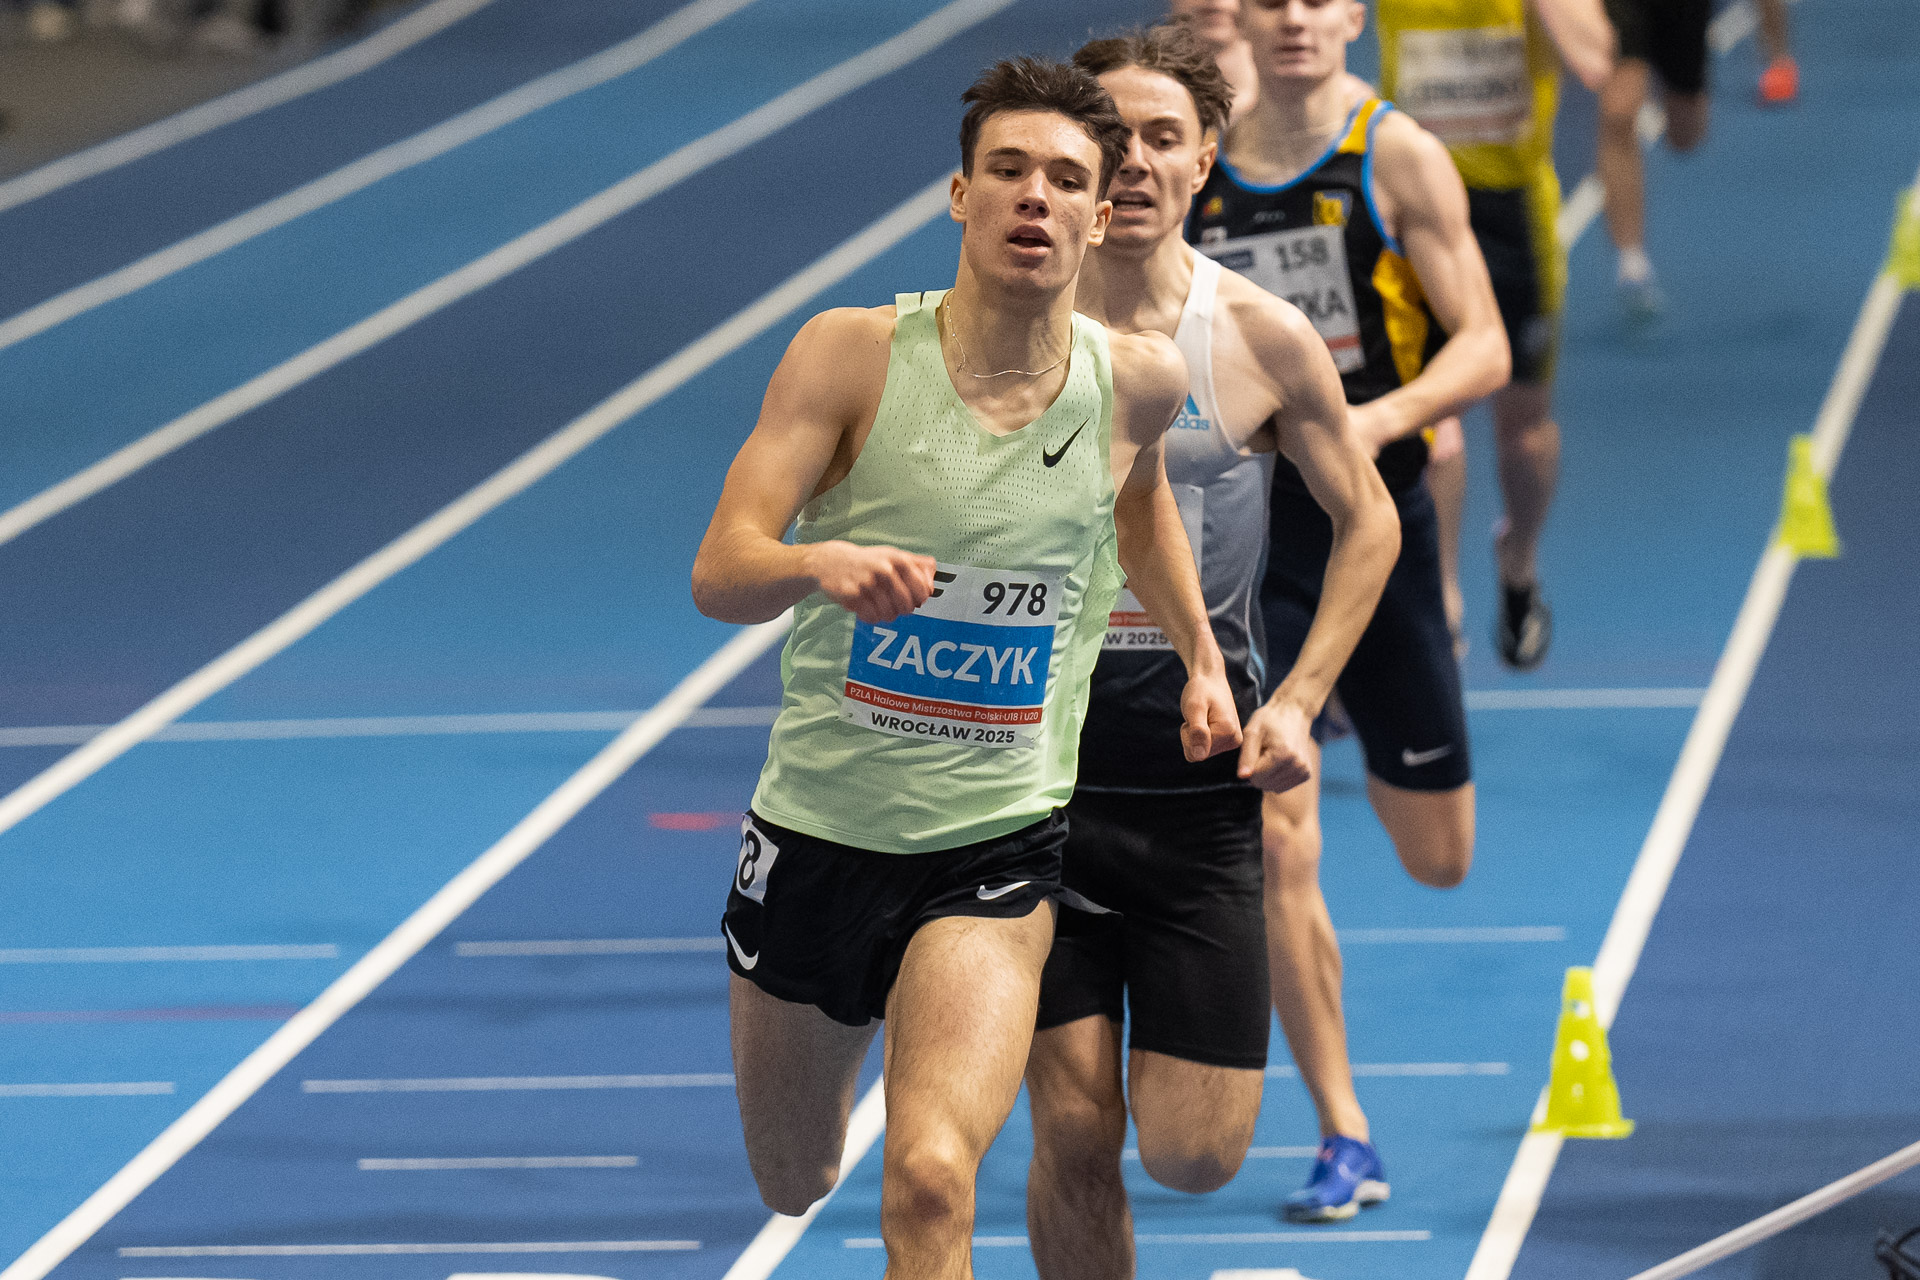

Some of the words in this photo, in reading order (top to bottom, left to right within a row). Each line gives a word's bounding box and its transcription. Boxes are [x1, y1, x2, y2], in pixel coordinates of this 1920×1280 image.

[1276, 236, 1329, 273] 158
[982, 581, 1048, 617] 978
[866, 625, 1039, 686] ZACZYK
[1127, 632, 1168, 645] 2025
[849, 686, 871, 701] PZLA
[873, 692, 910, 710] Halowe
[912, 703, 973, 719] Mistrzostwa
[1024, 711, 1039, 722] U20
[871, 711, 972, 741] WROCŁAW
[974, 728, 1016, 744] 2025
